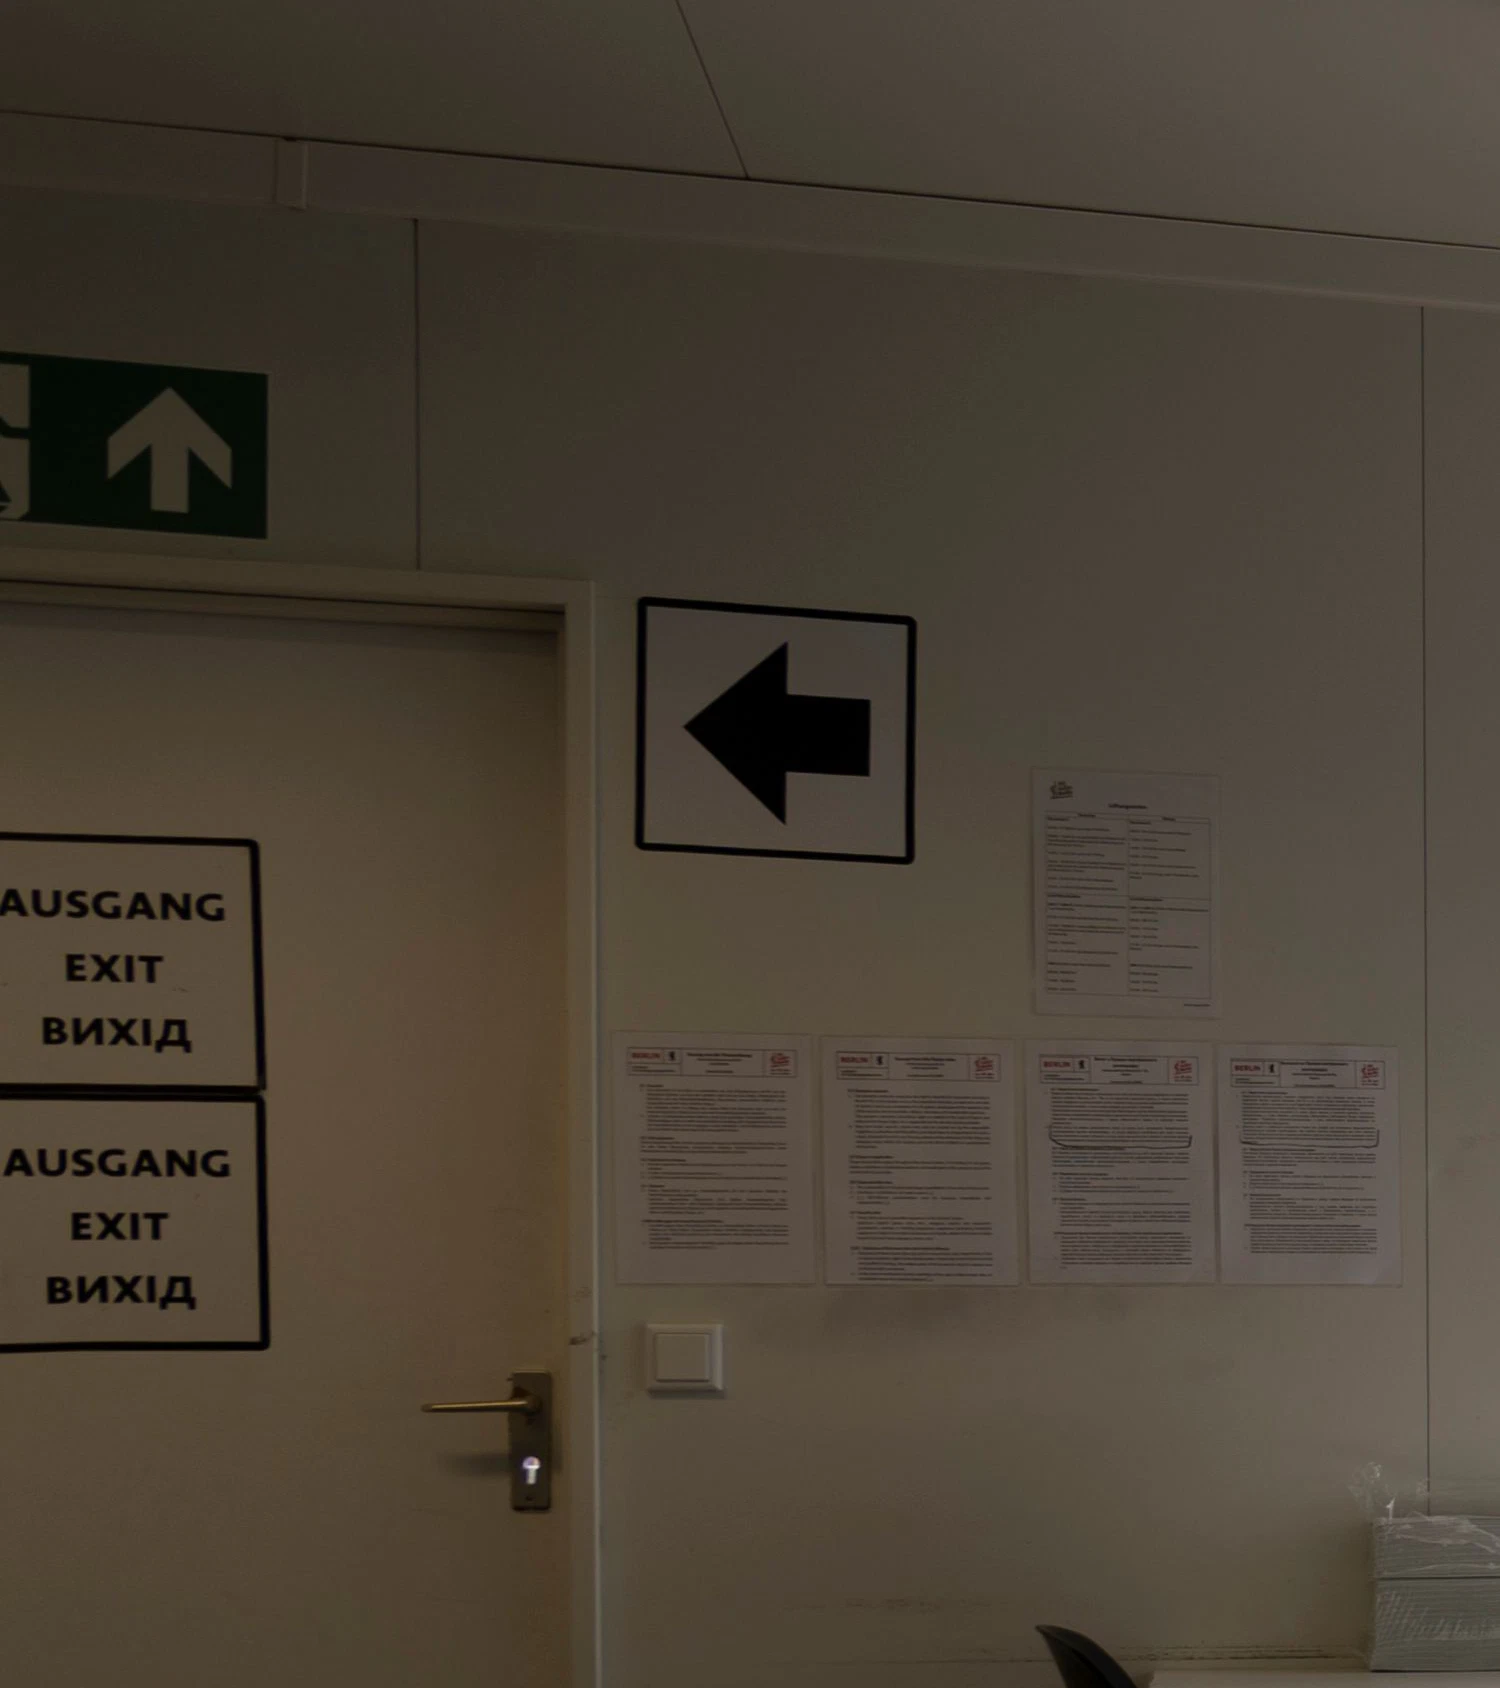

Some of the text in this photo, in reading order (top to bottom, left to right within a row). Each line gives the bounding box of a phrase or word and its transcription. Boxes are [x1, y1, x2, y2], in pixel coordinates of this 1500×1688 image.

[0, 888, 226, 921] AUSGANG
[65, 954, 164, 983] EXIT
[42, 1017, 192, 1053] ВИХІД
[3, 1148, 230, 1177] AUSGANG
[70, 1212, 170, 1240] EXIT
[46, 1275, 197, 1310] ВИХІД
